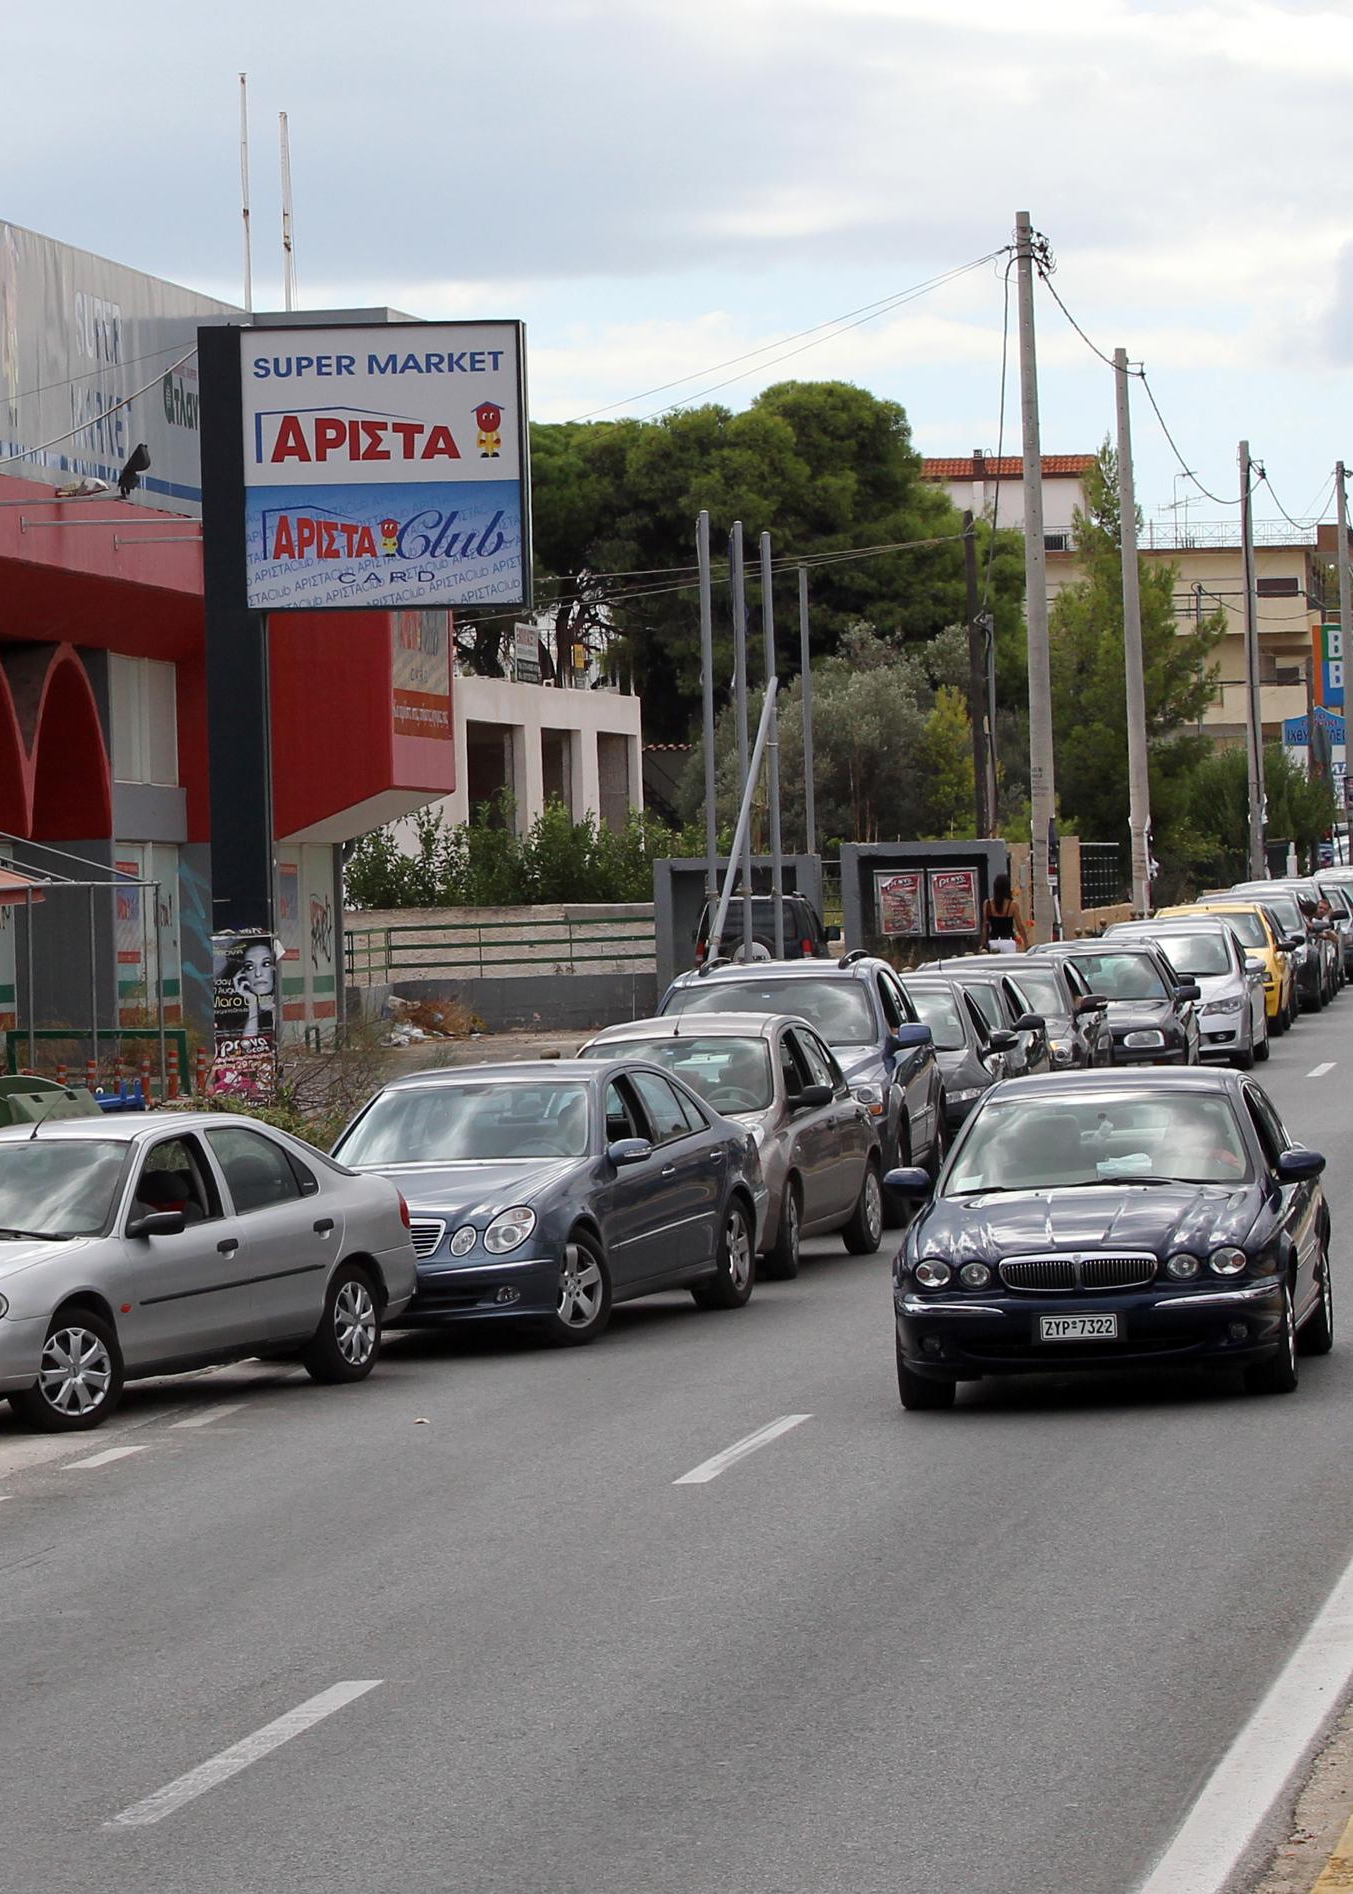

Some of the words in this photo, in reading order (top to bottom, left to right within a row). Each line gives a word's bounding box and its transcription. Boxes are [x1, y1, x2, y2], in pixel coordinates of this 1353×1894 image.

[253, 355, 356, 379] SUPER
[367, 350, 504, 376] MARKET
[270, 414, 462, 464] ΑΡΙΣΤΑ
[272, 514, 378, 560] ΑΡΙΣΤΑ
[396, 508, 506, 560] Club
[338, 571, 436, 585] CARD
